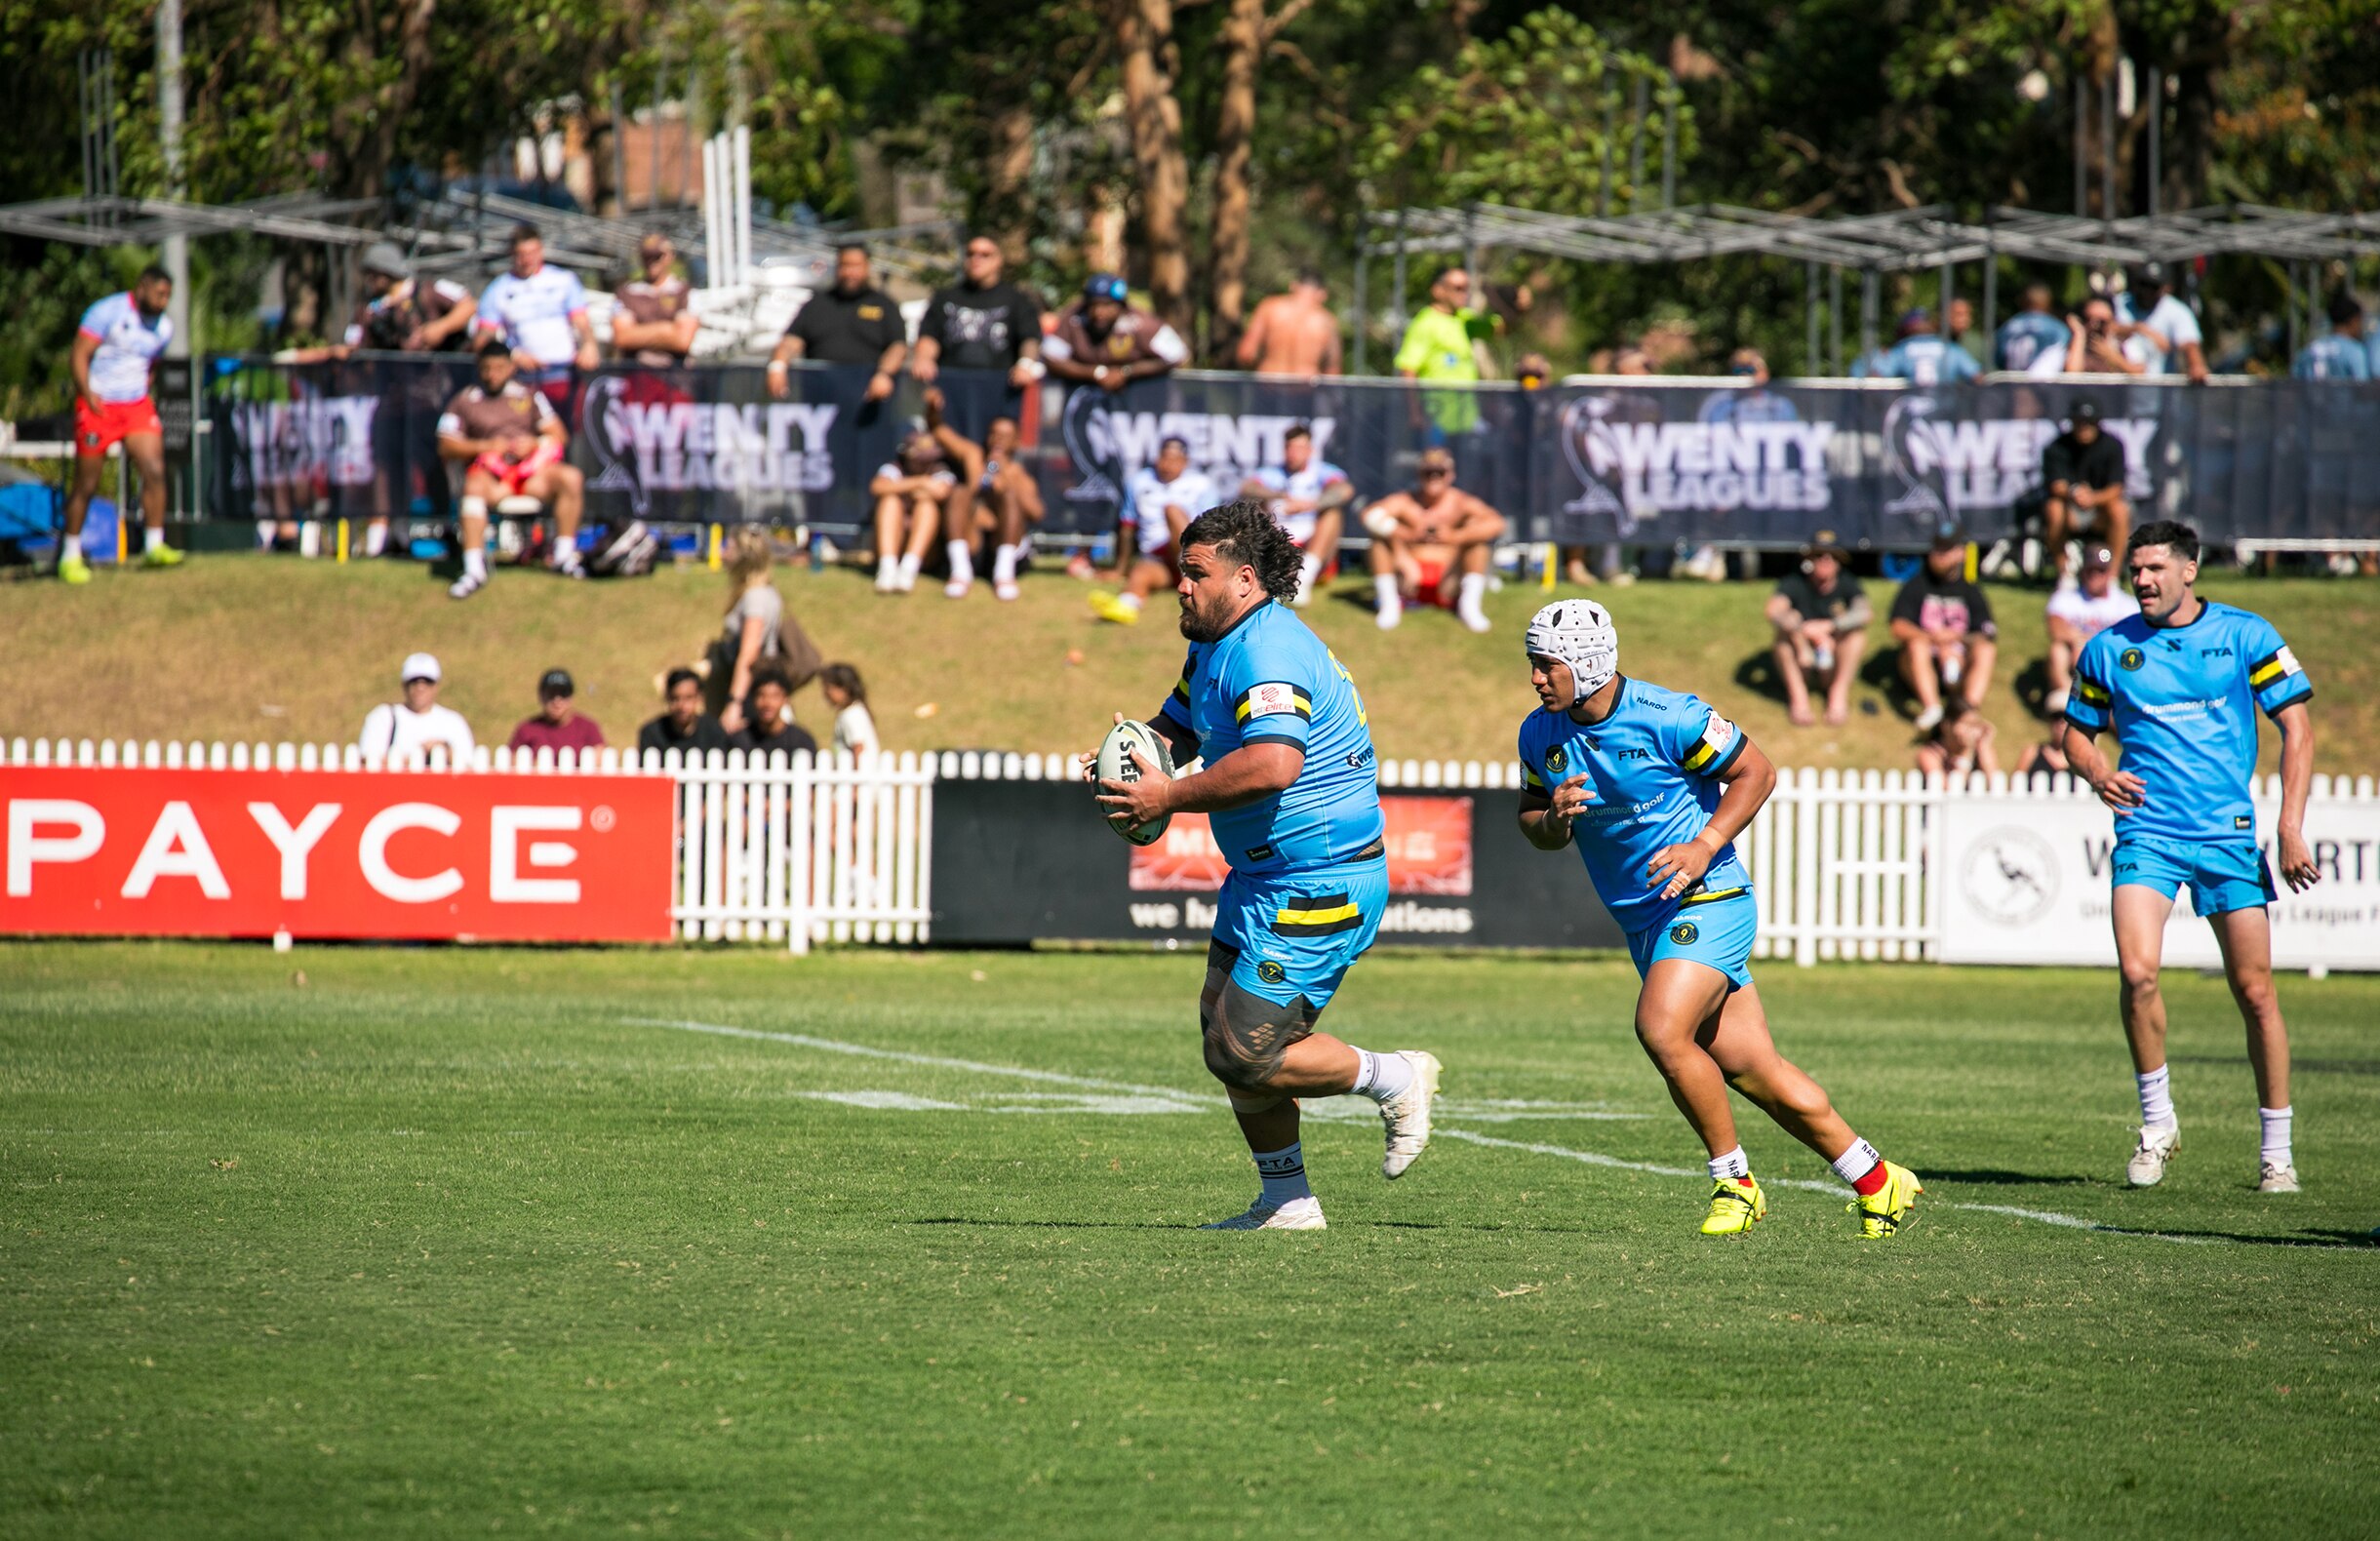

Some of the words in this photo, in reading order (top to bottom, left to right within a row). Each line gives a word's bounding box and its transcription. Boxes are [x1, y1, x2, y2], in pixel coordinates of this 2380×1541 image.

[625, 401, 837, 451] WENTY
[1610, 421, 1834, 472] WENTY
[1931, 419, 2158, 470] WEY
[638, 451, 834, 490] LEAGUES
[1622, 470, 1831, 510] LEAGUES
[2202, 647, 2234, 658] FTA
[1637, 696, 1667, 712] NARDO
[1618, 747, 1649, 761] FTA
[1583, 803, 1641, 818] drummond
[1642, 792, 1665, 811] golf
[5, 798, 582, 903] PAYCE
[2290, 903, 2364, 928] League
[1680, 929, 1688, 940] 9
